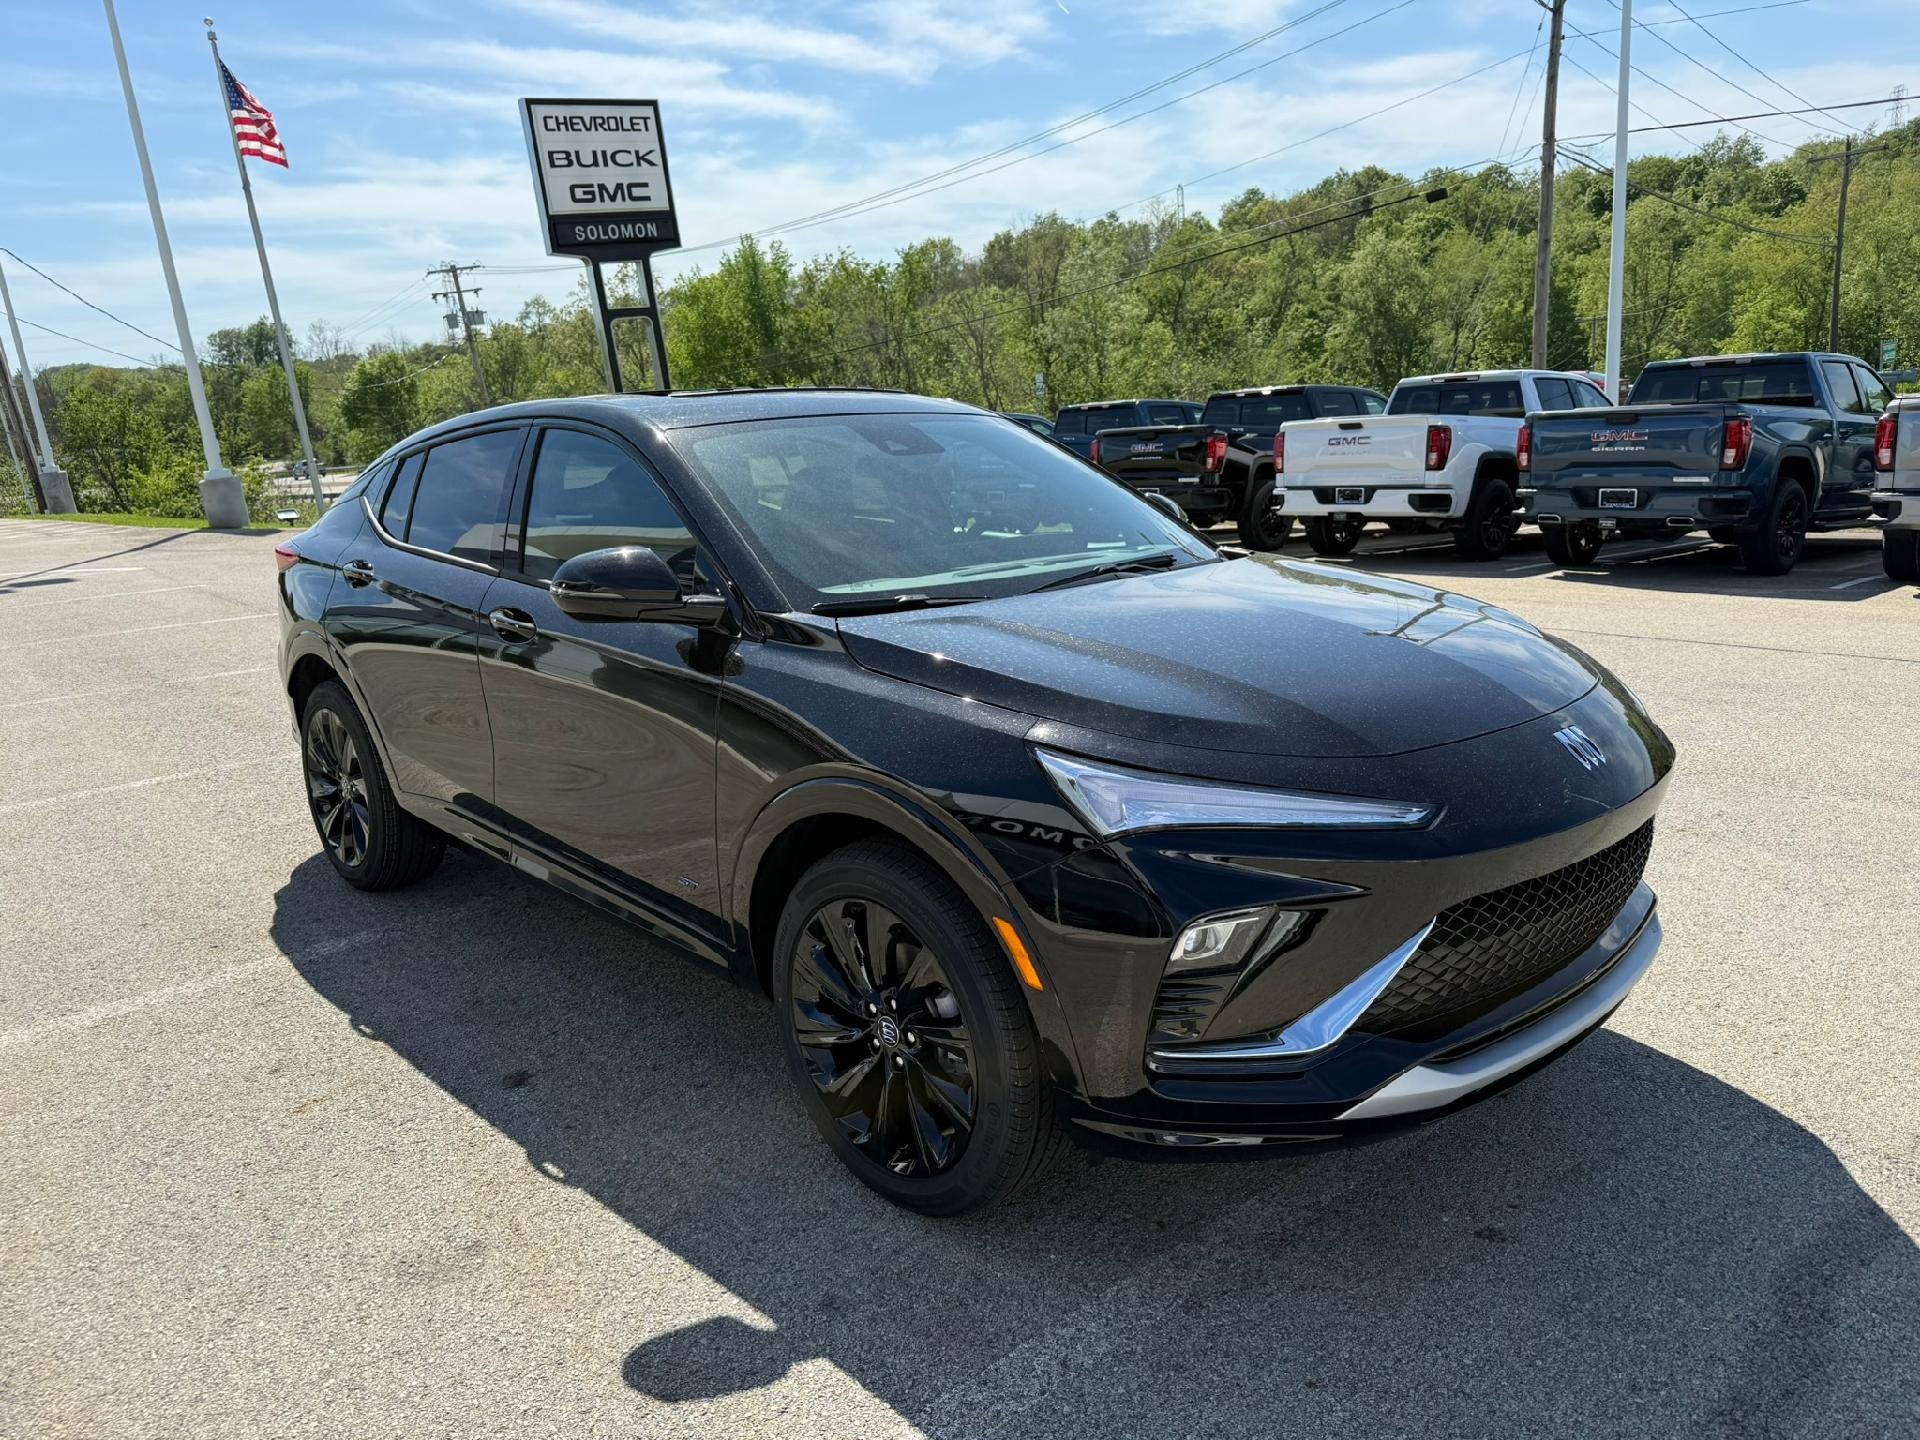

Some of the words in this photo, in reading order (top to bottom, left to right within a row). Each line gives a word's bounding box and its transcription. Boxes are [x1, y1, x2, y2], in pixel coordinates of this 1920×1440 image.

[543, 115, 651, 132] CHEVROLET
[547, 149, 658, 168] BUICK
[569, 182, 652, 203] GMC
[575, 222, 658, 241] SOLOMON
[1328, 436, 1372, 446] GMC
[1591, 429, 1649, 441] GMC
[1130, 442, 1164, 453] GMC
